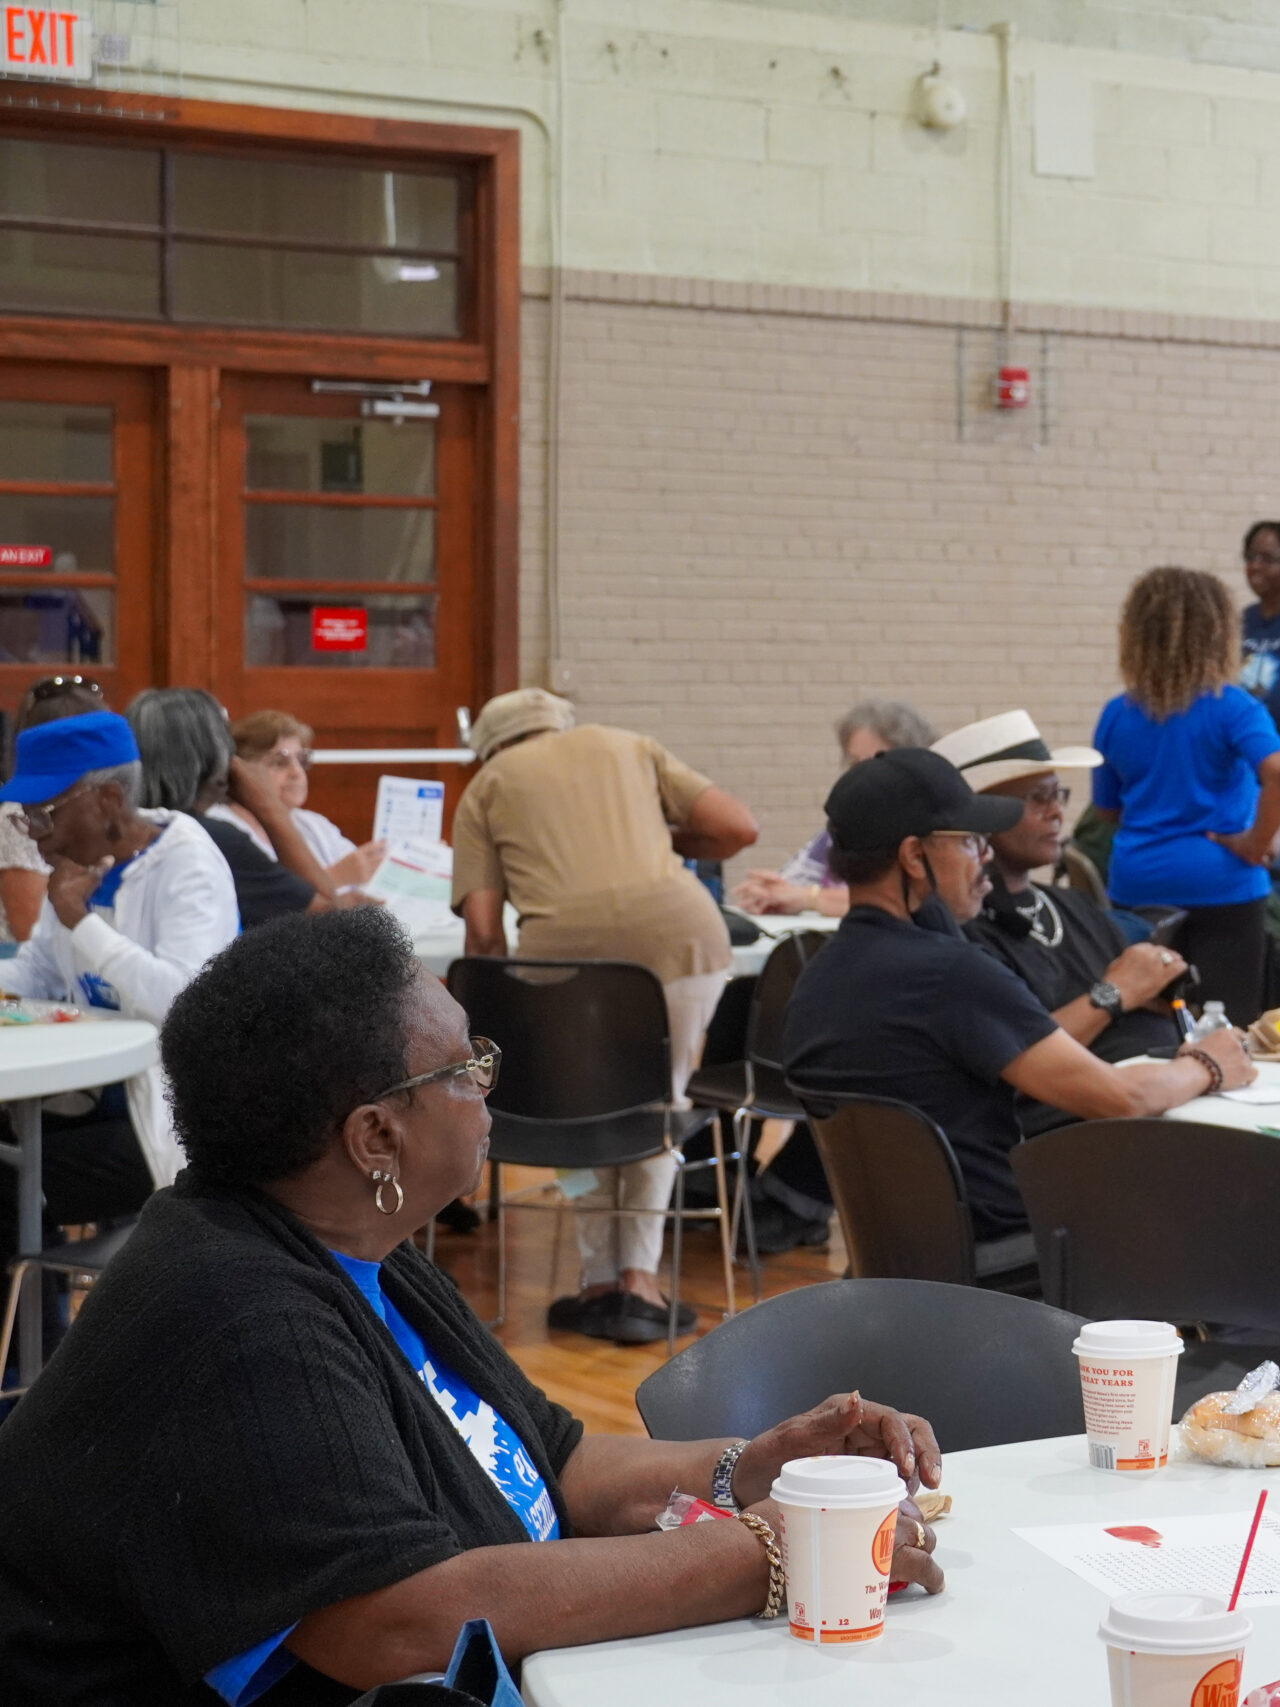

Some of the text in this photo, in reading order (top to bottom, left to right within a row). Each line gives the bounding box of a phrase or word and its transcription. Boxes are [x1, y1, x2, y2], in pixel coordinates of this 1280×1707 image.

[5, 6, 78, 68] EXIT
[1092, 1367, 1108, 1376] YOU
[1112, 1369, 1134, 1377] FOR
[1101, 1378, 1134, 1386] YEARS
[838, 1618, 849, 1626] 12
